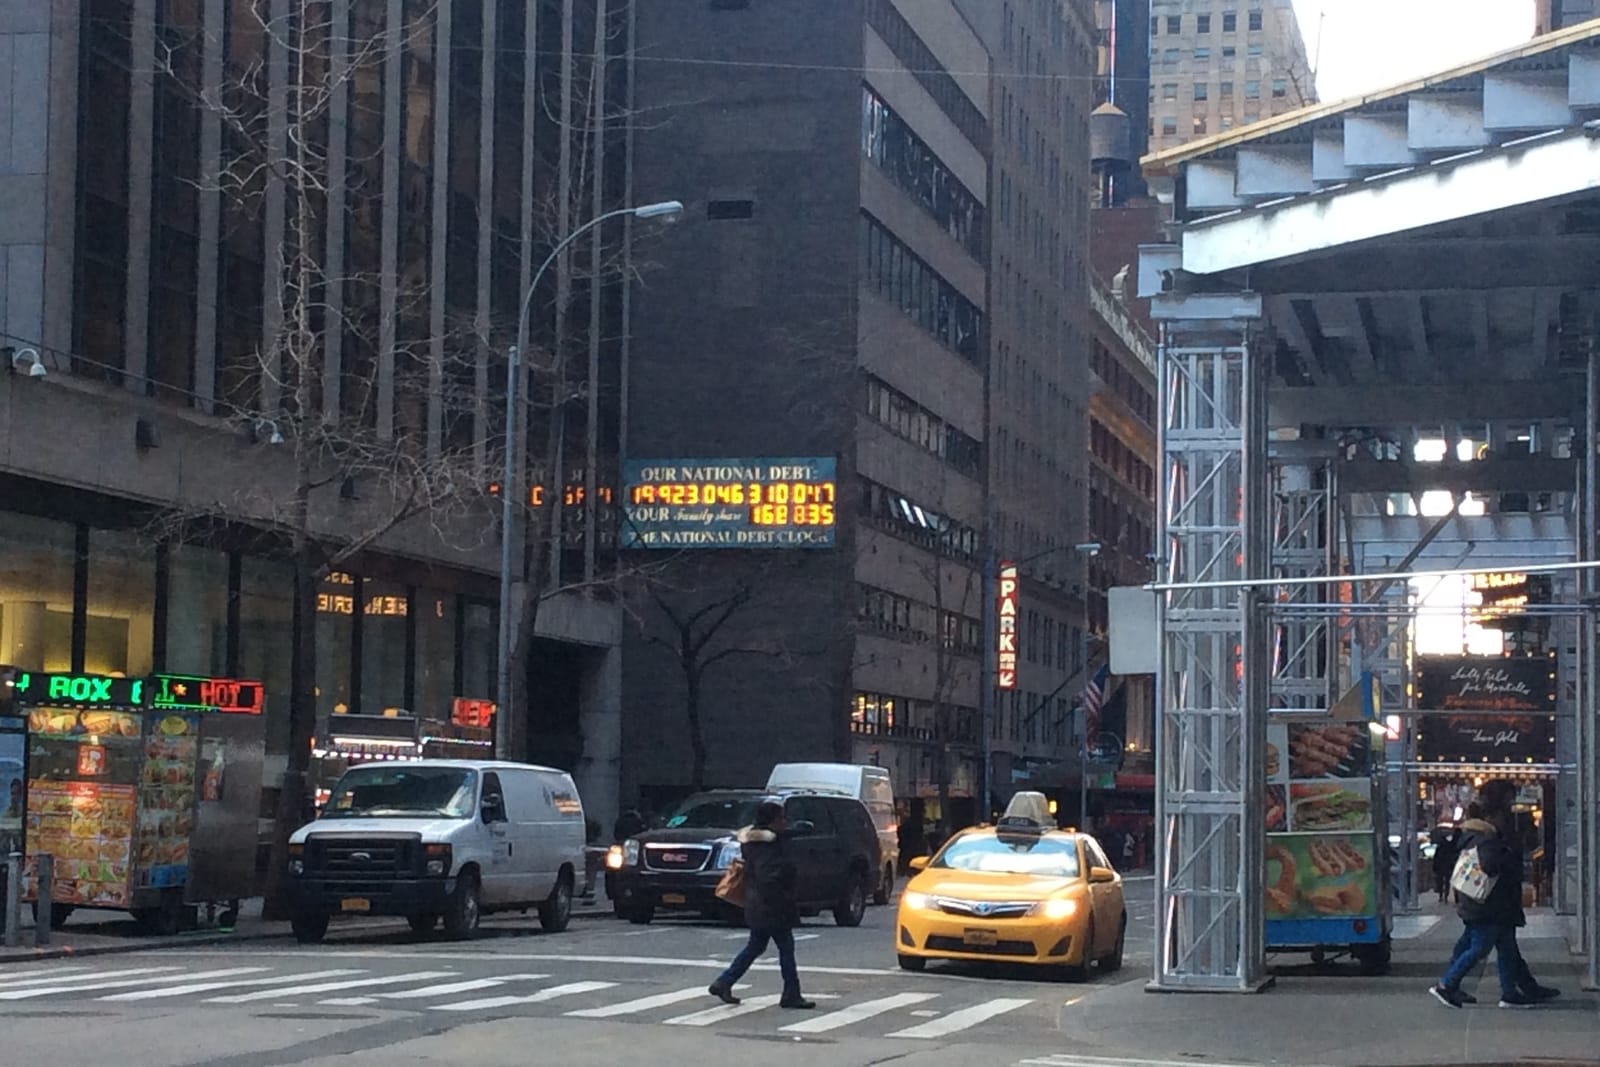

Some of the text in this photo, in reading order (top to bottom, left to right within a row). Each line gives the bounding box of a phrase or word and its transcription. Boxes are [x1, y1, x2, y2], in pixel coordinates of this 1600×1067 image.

[641, 467, 676, 481] OUR
[681, 466, 765, 481] NATIONAL
[625, 507, 670, 521] YOUR
[660, 531, 734, 543] NATIONAL
[737, 531, 775, 543] DEBT
[201, 681, 240, 706] HOT
